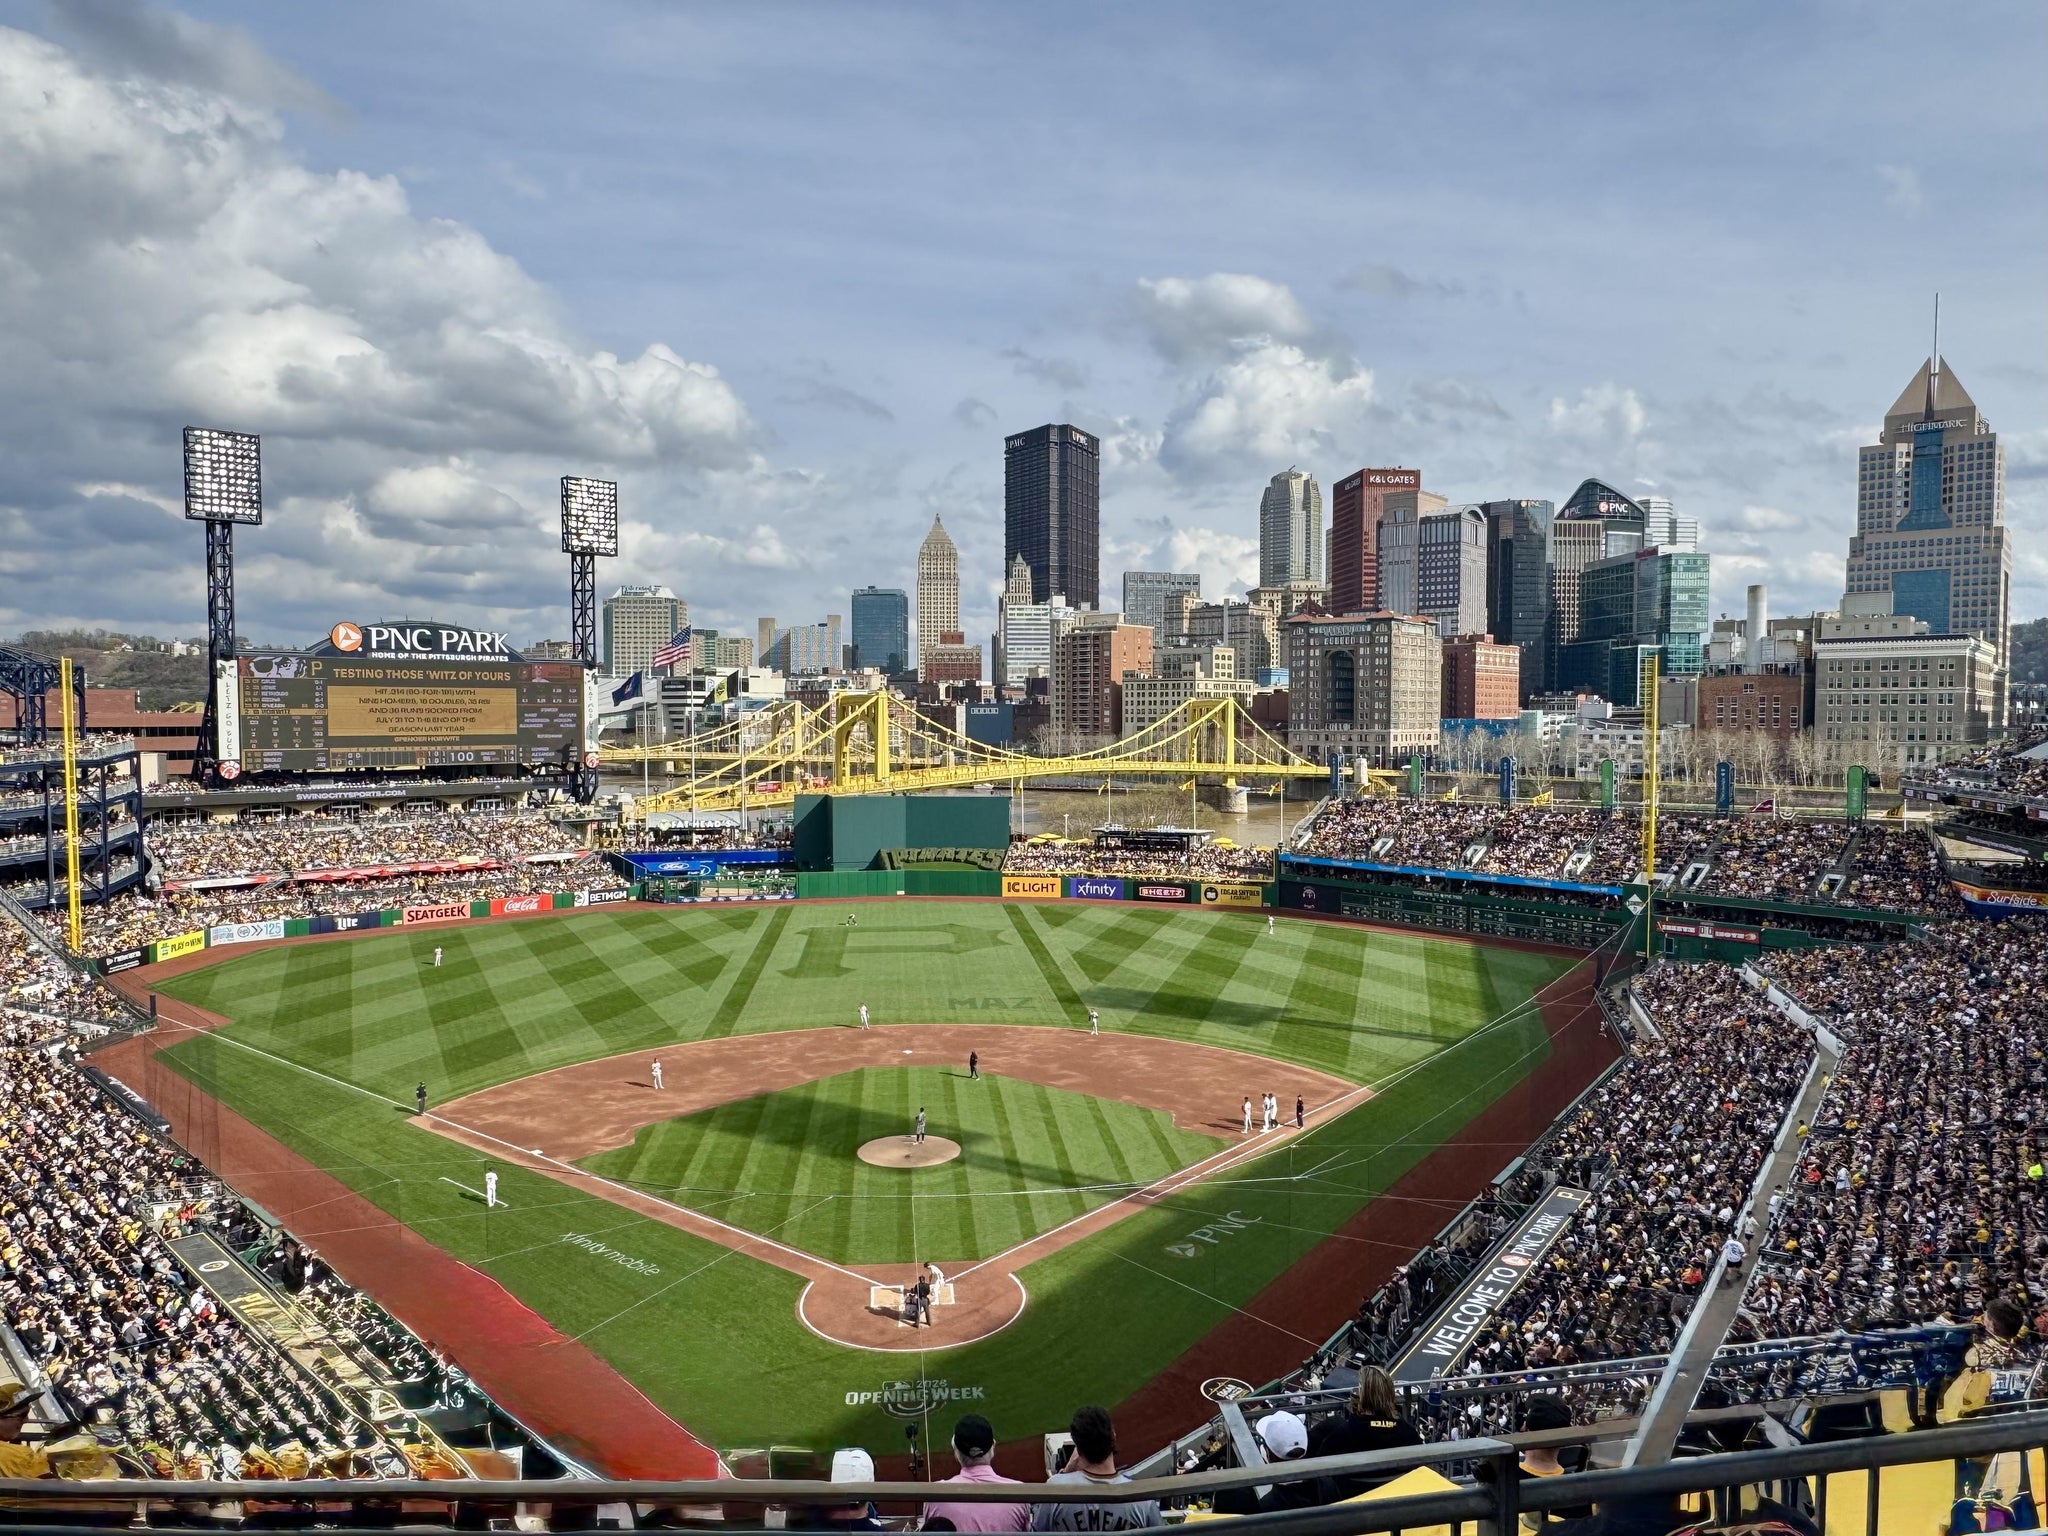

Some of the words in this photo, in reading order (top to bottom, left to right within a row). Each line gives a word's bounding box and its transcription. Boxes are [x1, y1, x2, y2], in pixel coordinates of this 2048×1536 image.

[1386, 476, 1415, 484] GATES
[1609, 504, 1628, 513] PNC
[367, 627, 432, 650] PNC
[439, 630, 510, 654] PARK
[411, 652, 427, 660] THE
[428, 653, 477, 661] PITTSBURGH
[478, 654, 508, 662] PIRATES
[311, 661, 322, 676] P
[333, 668, 384, 678] TESTING
[385, 669, 423, 679] THOSE
[426, 670, 456, 680] 'WITZ
[459, 671, 472, 680] OF
[474, 671, 511, 681] YOURS
[450, 752, 474, 762] 100
[694, 820, 732, 828] HEAD'S
[1022, 883, 1056, 893] LIGHT
[1078, 882, 1116, 897] xfinity
[590, 891, 627, 902] BETMGM
[1986, 891, 2038, 906] Surfside
[407, 905, 466, 922] SEATGEEK
[264, 922, 282, 936] 125
[1186, 1210, 1262, 1244] PNC
[559, 1232, 611, 1254] xfinity
[604, 1250, 660, 1276] mobile
[1422, 1284, 1502, 1356] WELCOME
[1484, 1267, 1518, 1284] TO
[1510, 1234, 1546, 1257] PNC
[1530, 1212, 1564, 1239] PARK
[845, 1389, 929, 1405] OPENING
[931, 1386, 985, 1400] WEEK
